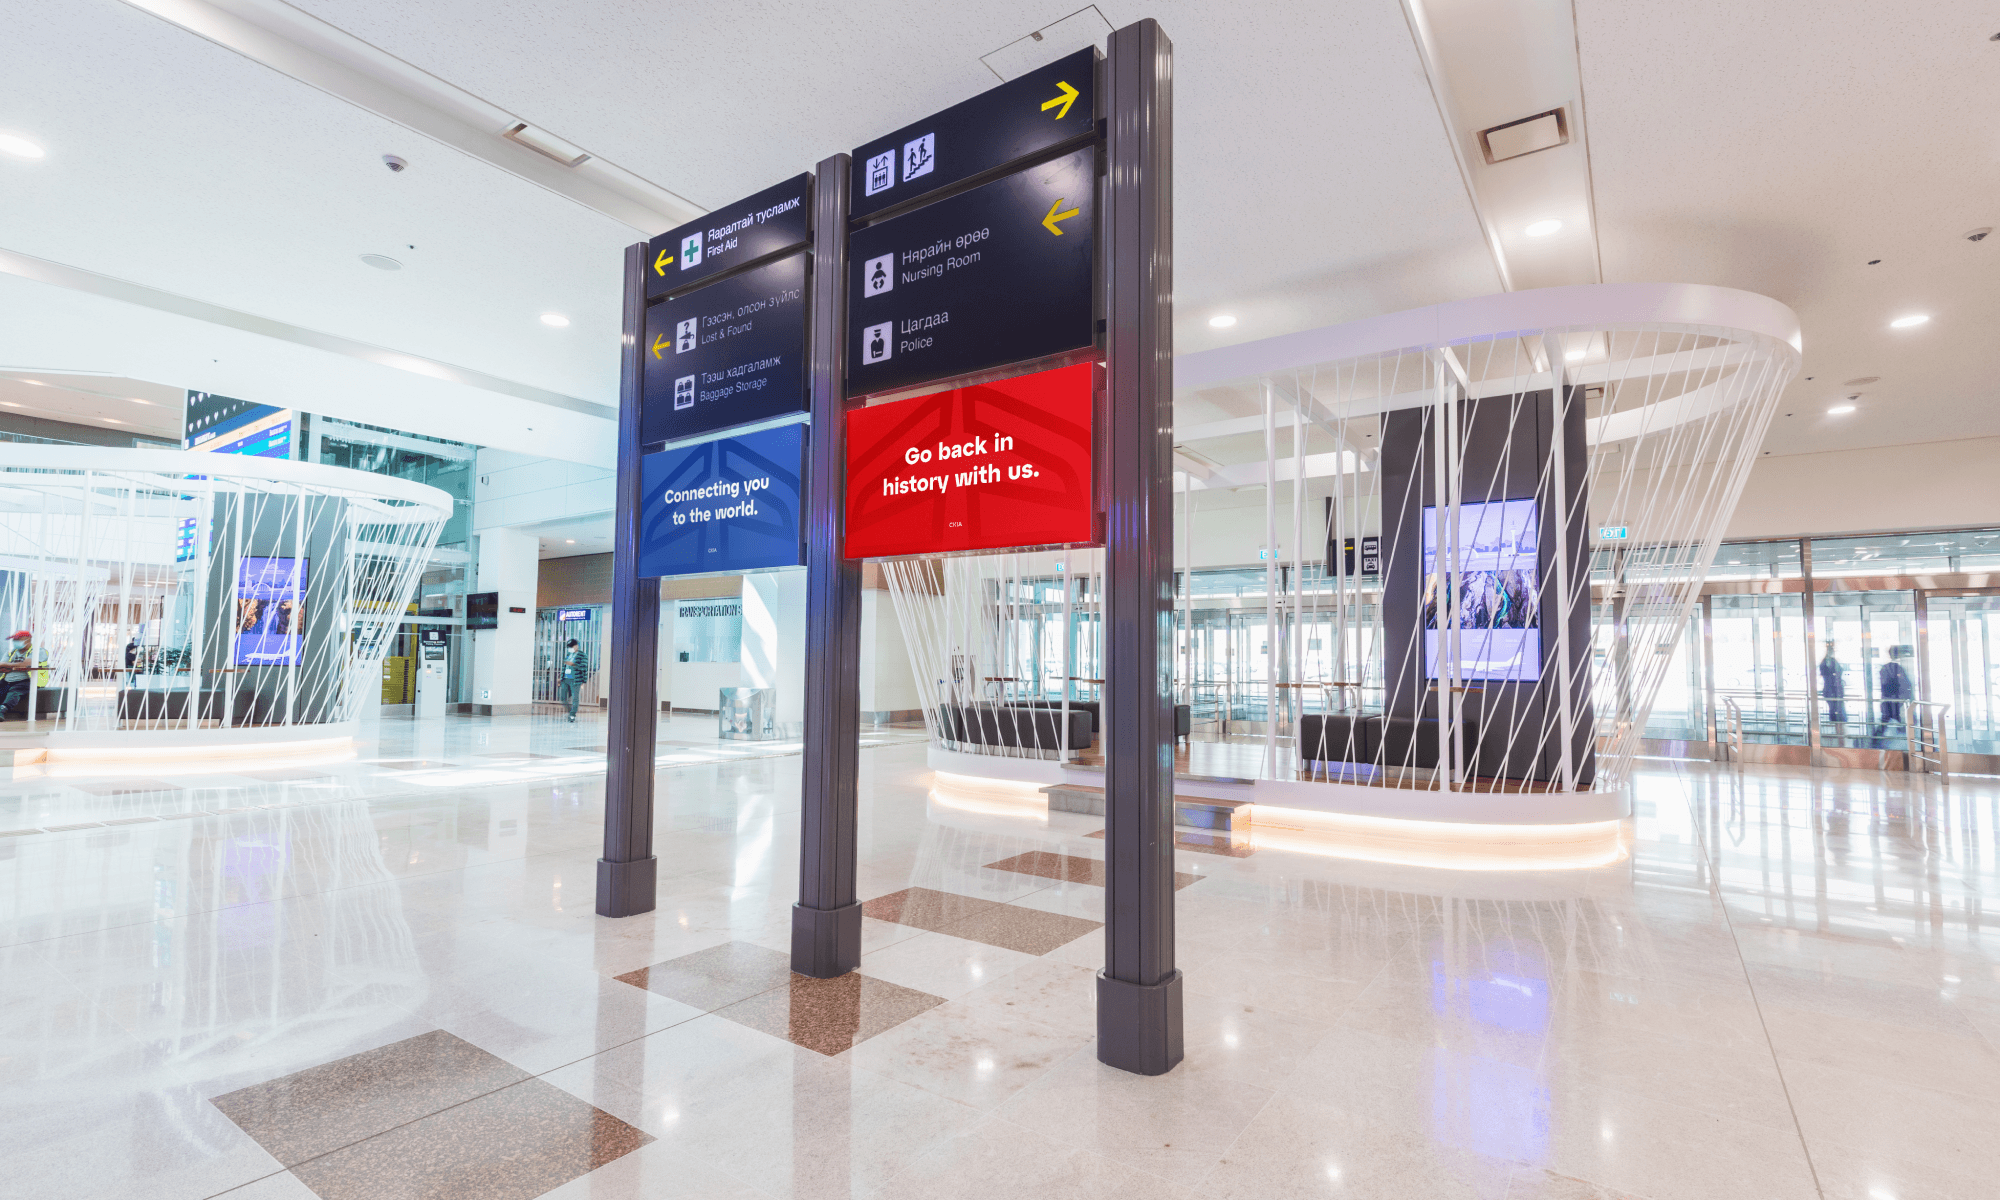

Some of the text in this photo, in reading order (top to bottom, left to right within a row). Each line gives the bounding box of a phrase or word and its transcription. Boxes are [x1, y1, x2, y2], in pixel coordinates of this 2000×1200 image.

[708, 196, 800, 242] Яаралтай тусламж
[707, 237, 738, 258] First Aid
[902, 227, 990, 265] Нярайн өрөө
[902, 251, 981, 284] Nursing Room
[703, 288, 800, 328] Гээсэн, олсон зүйлс
[701, 320, 752, 345] Lost & Found
[901, 311, 949, 334] Цагдаа
[900, 337, 933, 353] Police
[701, 356, 781, 385] Тээш хадгаламж
[700, 378, 767, 401] Baggage Storage
[905, 432, 1014, 465] Go back in
[664, 477, 769, 504] Connecting you
[883, 463, 1040, 497] history with us.
[672, 499, 758, 525] to the world.
